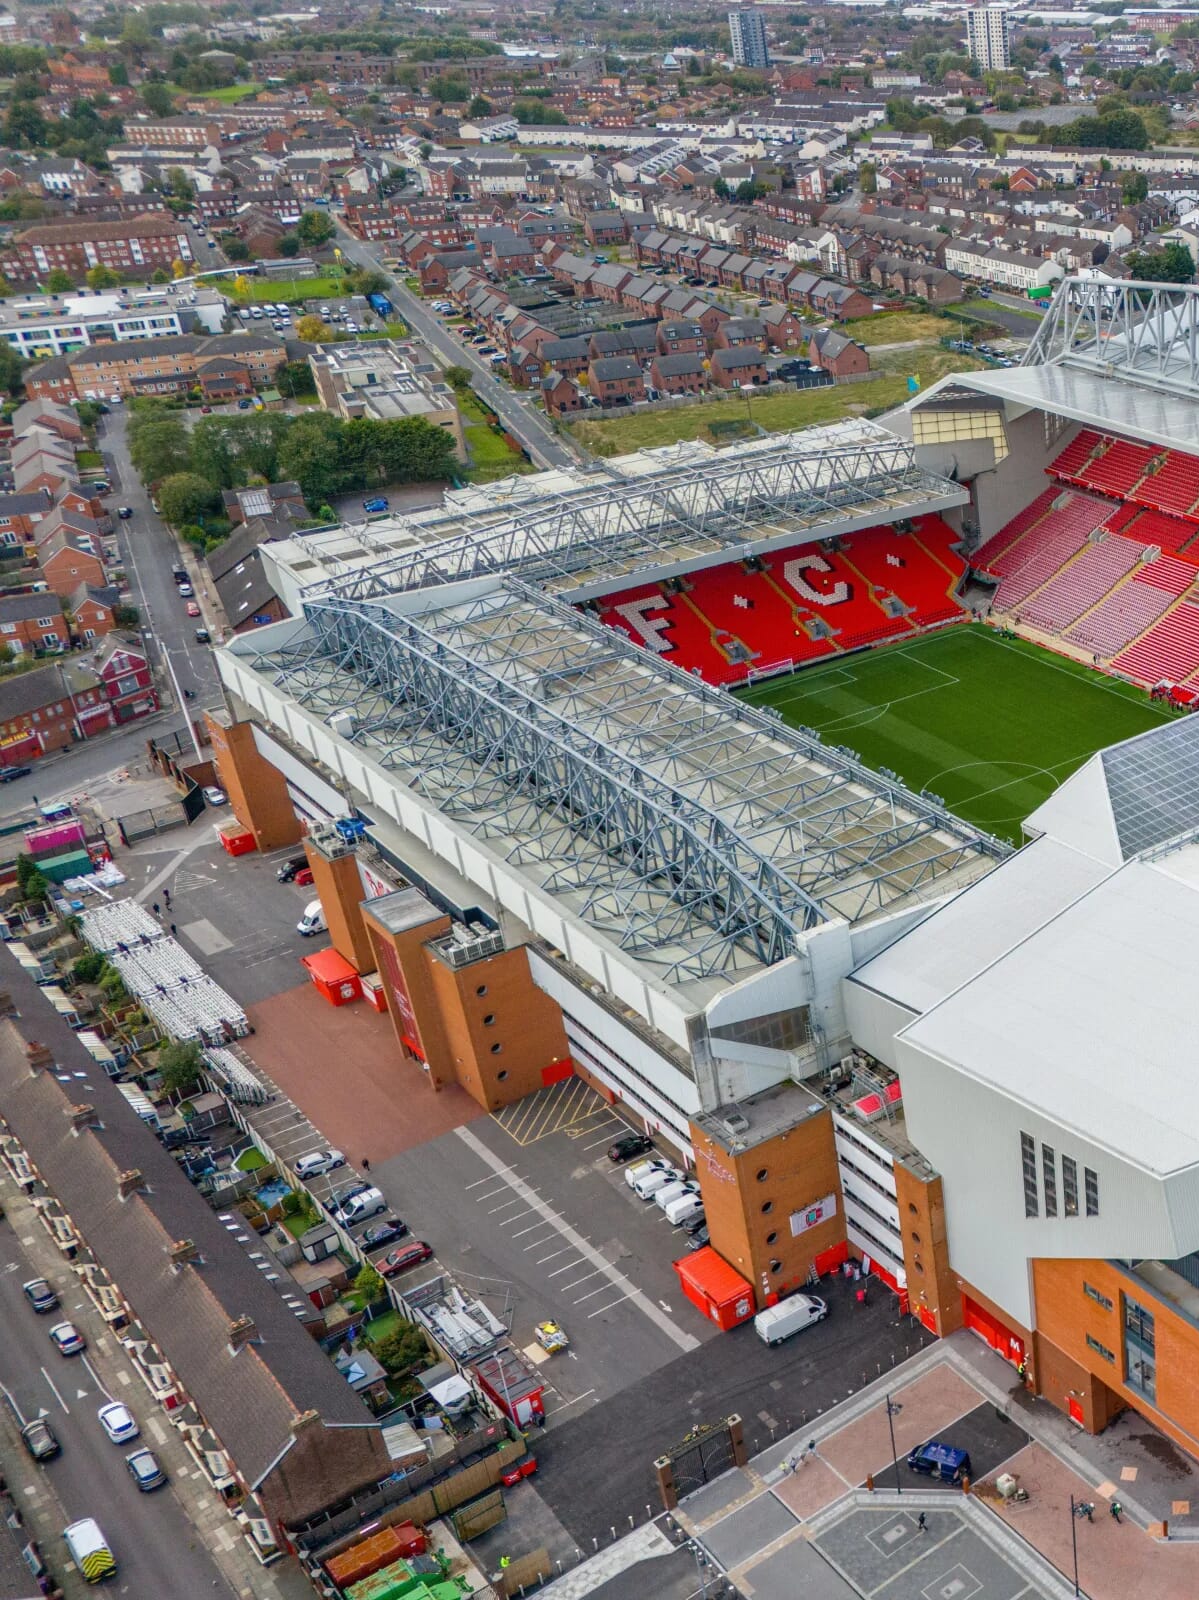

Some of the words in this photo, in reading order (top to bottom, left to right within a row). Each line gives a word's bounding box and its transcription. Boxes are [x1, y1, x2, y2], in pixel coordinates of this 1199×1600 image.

[614, 594, 675, 653] F
[783, 554, 849, 606] C
[1010, 1337, 1020, 1353] M
